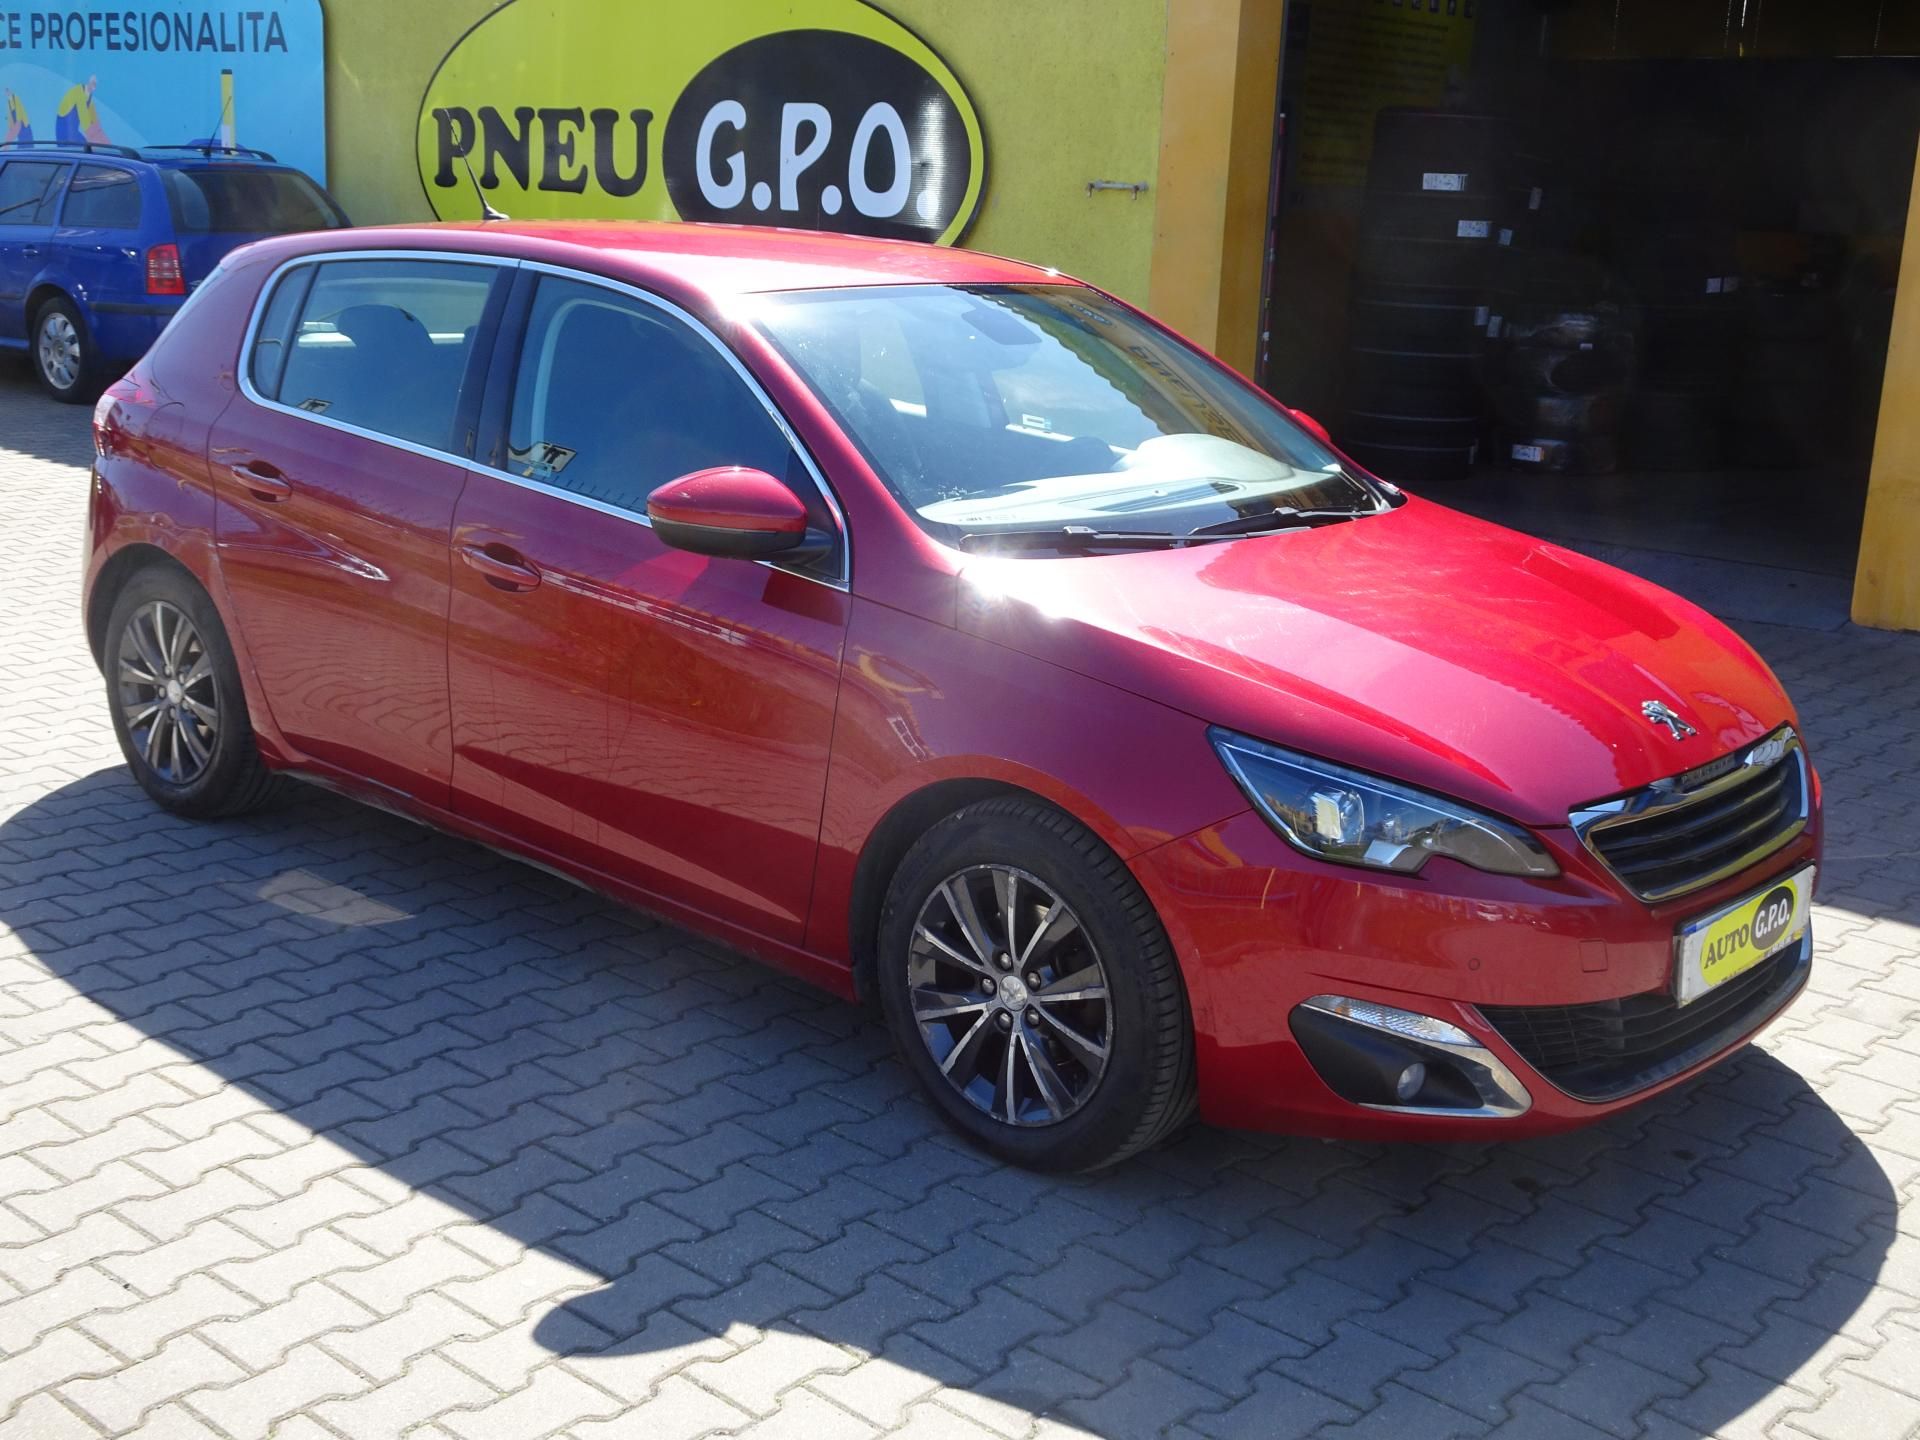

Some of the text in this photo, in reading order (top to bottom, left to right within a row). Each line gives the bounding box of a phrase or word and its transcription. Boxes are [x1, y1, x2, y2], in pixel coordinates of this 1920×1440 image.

[31, 11, 288, 53] PROFESIONALITA
[432, 99, 940, 219] PNEU G.P.O.
[1704, 923, 1749, 969] AUTO
[1755, 898, 1790, 938] G.P.O.
